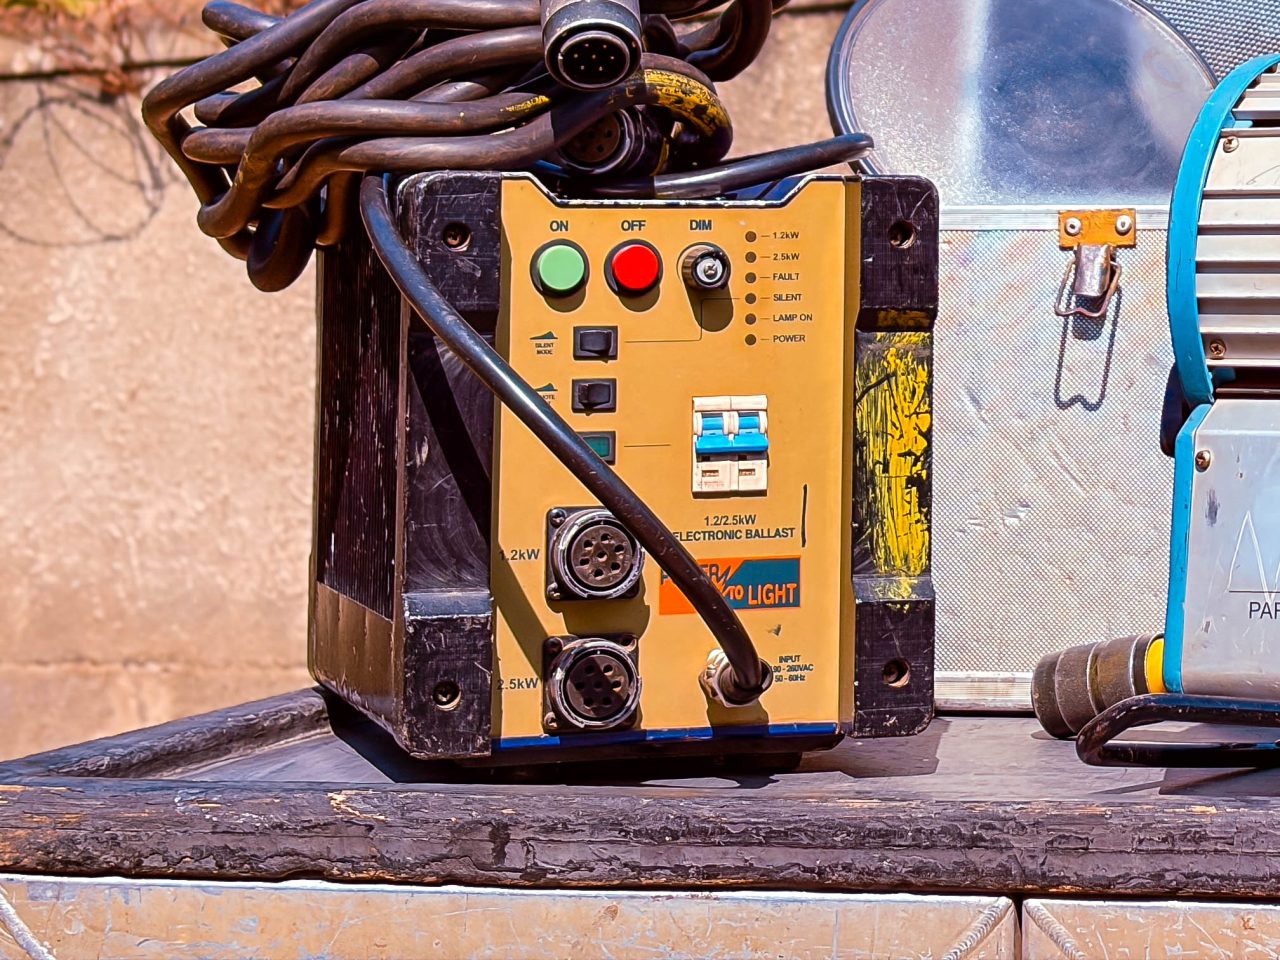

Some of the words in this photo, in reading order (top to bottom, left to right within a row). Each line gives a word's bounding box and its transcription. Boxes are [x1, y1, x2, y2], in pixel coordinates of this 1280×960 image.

[550, 220, 569, 232] ON
[621, 220, 646, 231] OFF
[689, 219, 712, 231] DIM
[772, 231, 800, 239] 1.2kW
[772, 253, 800, 261] 2.5kW
[773, 314, 798, 322] LAMP
[799, 313, 813, 321] ON
[704, 514, 757, 526] 1.2/2.5kW
[745, 527, 796, 539] BALLAST
[500, 548, 540, 561] 1.2kW
[747, 583, 798, 605] LIGHT
[779, 655, 801, 663] INPUT
[497, 678, 538, 690] 2.5kW
